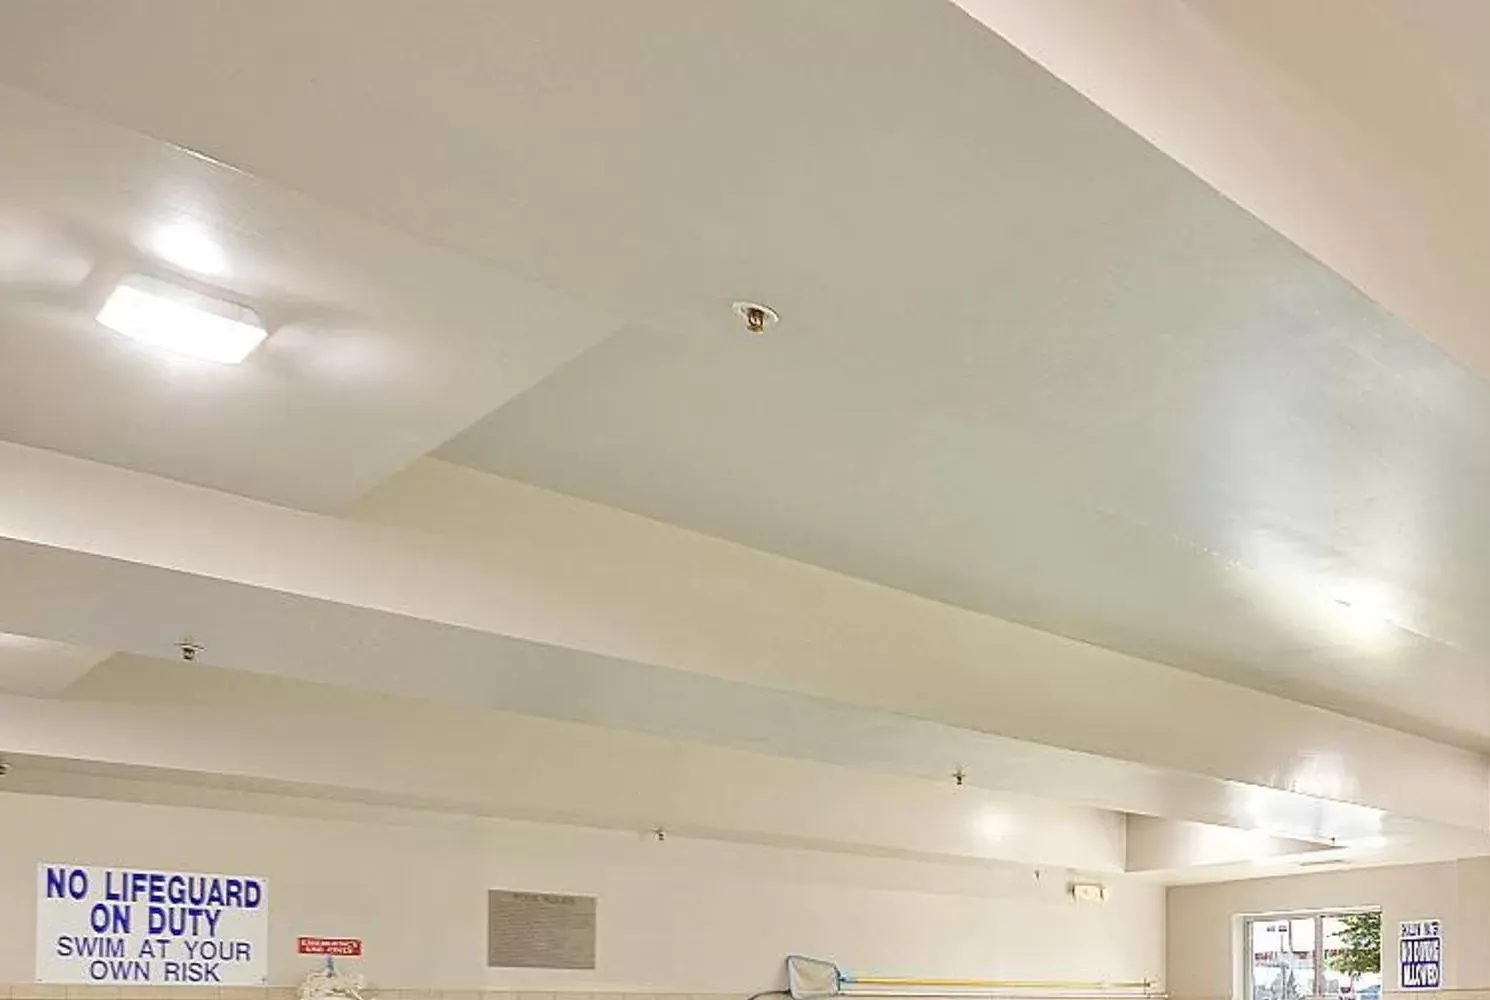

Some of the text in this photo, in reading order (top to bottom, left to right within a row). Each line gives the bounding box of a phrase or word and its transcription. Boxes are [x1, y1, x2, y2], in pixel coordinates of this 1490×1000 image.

[47, 868, 262, 908] NO LIFEGUARD
[90, 903, 221, 937] ON DUTY
[56, 936, 251, 961] SWIM AT YOUR
[89, 960, 220, 982] OWN RISK
